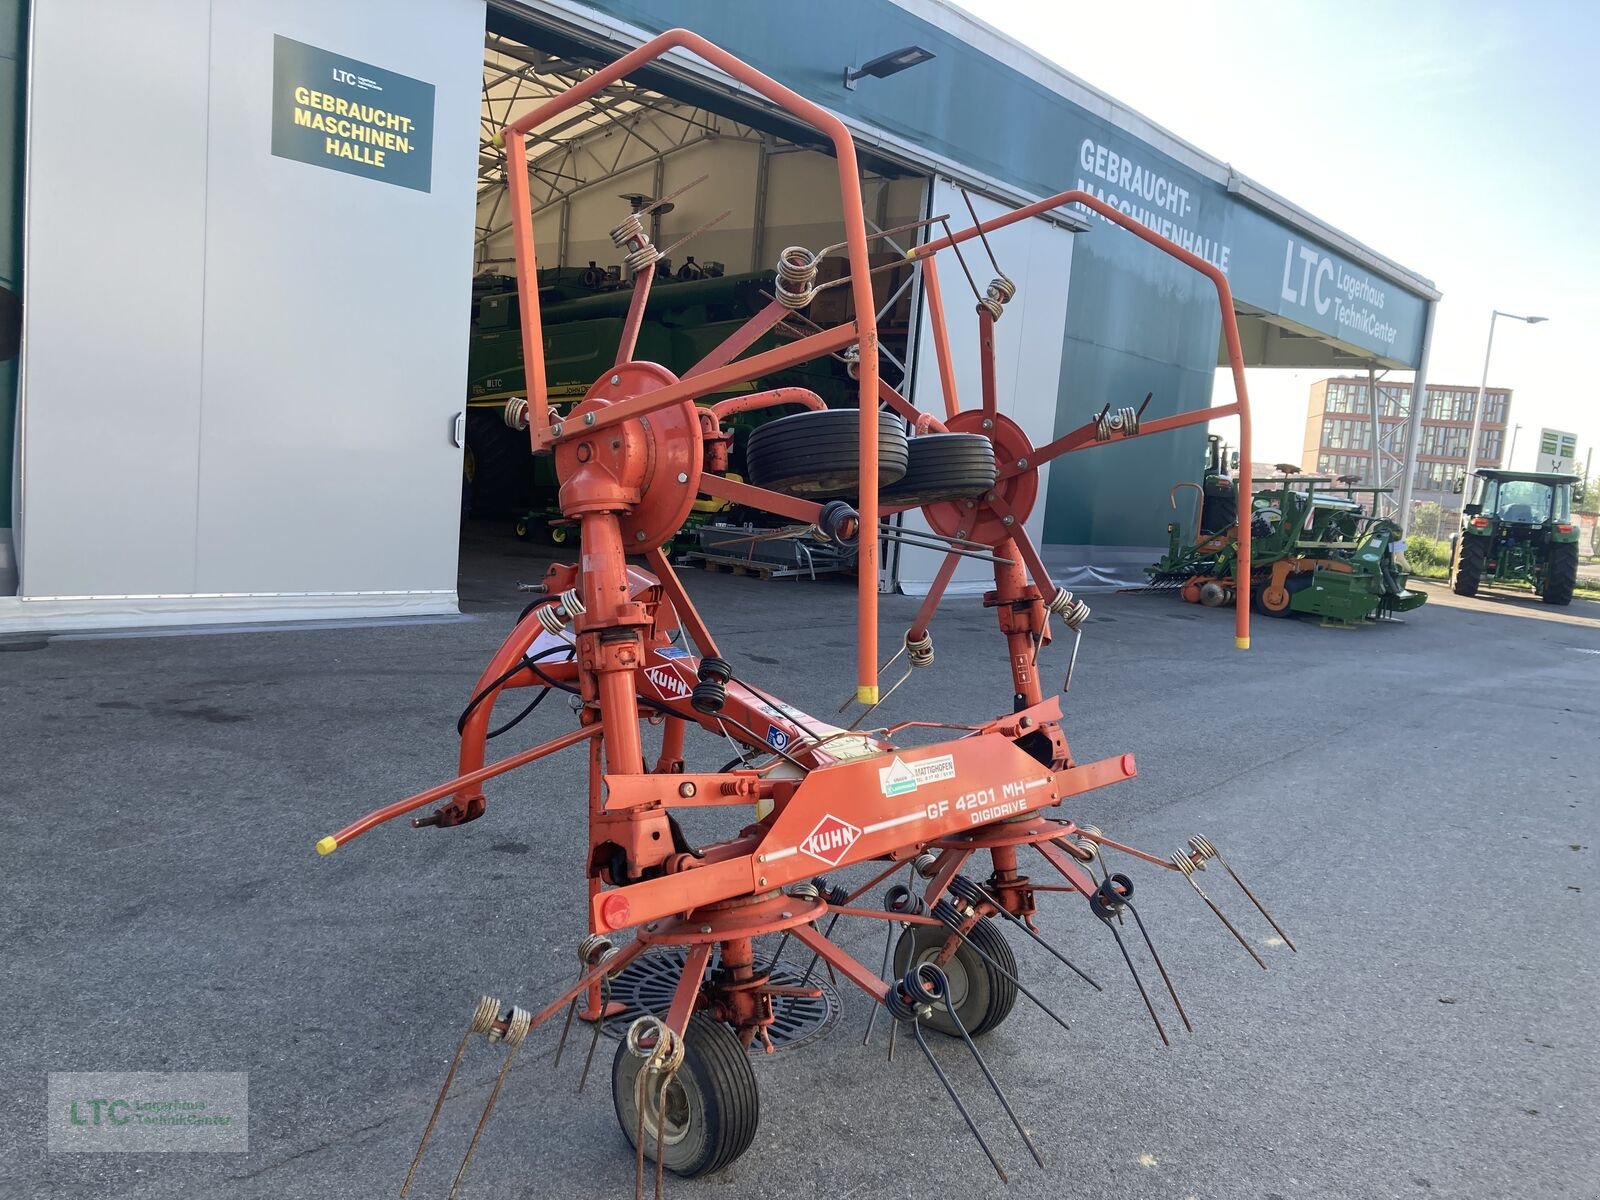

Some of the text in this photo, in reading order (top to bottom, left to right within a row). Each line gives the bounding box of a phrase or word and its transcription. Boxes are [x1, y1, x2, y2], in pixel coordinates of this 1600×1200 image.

[332, 68, 356, 86] LTC
[294, 86, 416, 134] GEBRAUCHT-
[294, 107, 415, 154] MASCHINEN-
[326, 137, 386, 168] HALLE
[1080, 138, 1192, 219] GEBRAUCHT-
[1281, 238, 1334, 316] LTC
[1336, 264, 1385, 310] Lagerhaus
[1334, 297, 1398, 345] TechnikCenter
[648, 667, 687, 697] KUHN
[926, 780, 1026, 820] GF 4201 MH
[970, 798, 1028, 825] DIGIDRIVE
[807, 826, 855, 855] KUHN
